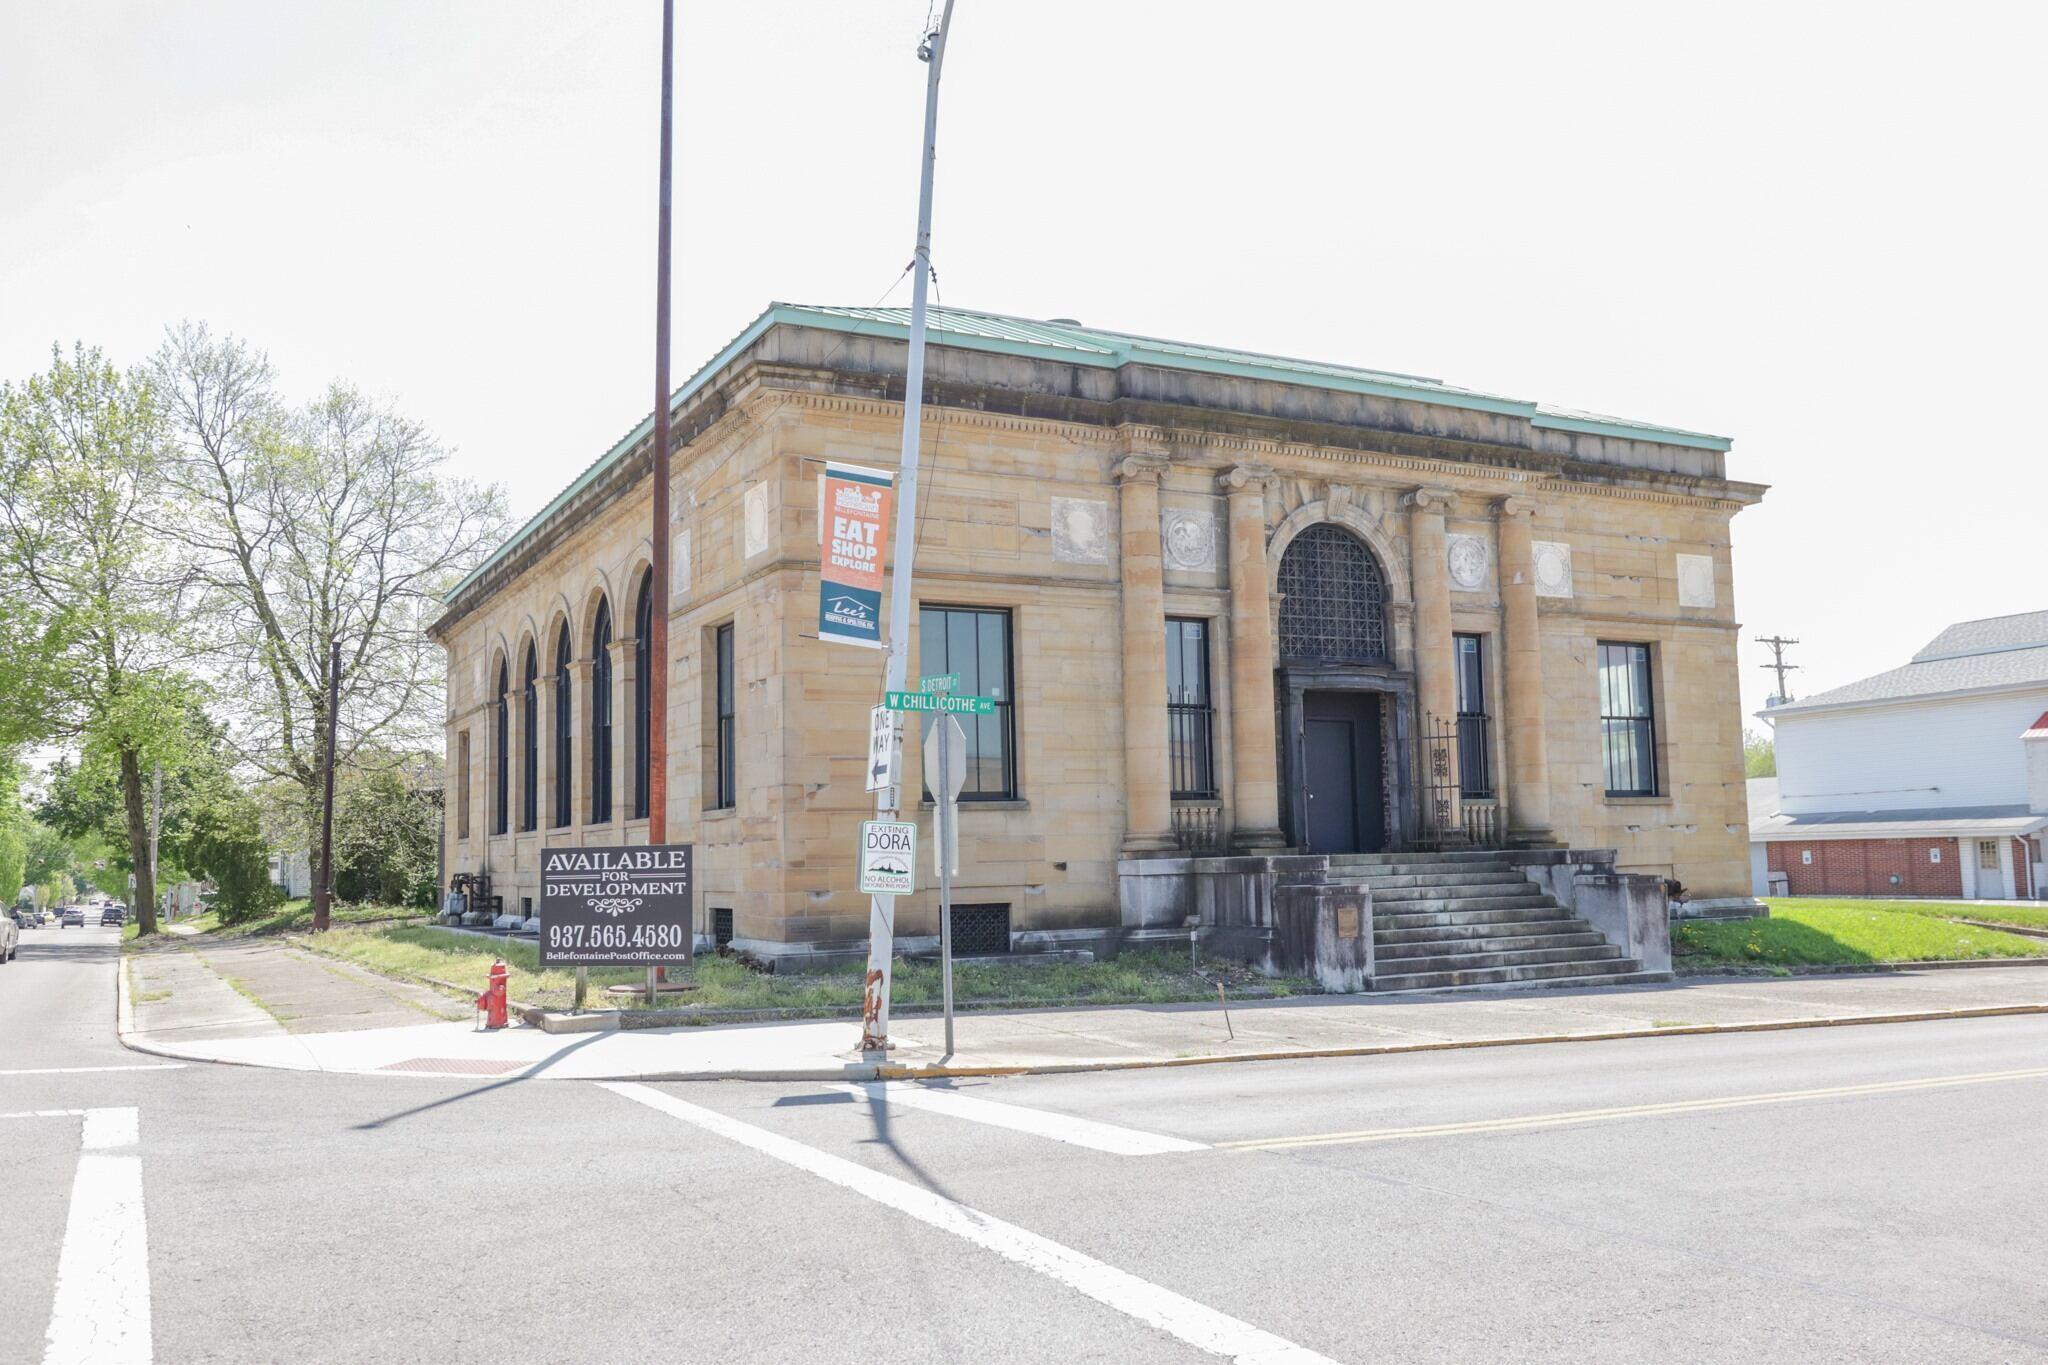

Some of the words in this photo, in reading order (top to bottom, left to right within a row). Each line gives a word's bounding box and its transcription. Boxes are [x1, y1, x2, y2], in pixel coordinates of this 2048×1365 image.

[833, 516, 880, 545] EAT
[831, 538, 877, 561] SHOP
[831, 554, 876, 573] EXPLORE
[833, 601, 867, 618] Lee's
[921, 680, 926, 693] S
[927, 676, 952, 692] DETROIT
[889, 693, 900, 708] W
[902, 694, 976, 712] CHILLICOTHE
[980, 702, 991, 710] AVE
[874, 710, 890, 731] ONE
[872, 732, 890, 755] WAY
[871, 825, 909, 834] EXITING
[867, 832, 911, 851] DORA
[545, 851, 686, 871] AVAILABLE
[601, 871, 629, 882] FOR
[864, 875, 876, 883] NO
[877, 875, 910, 884] ALCOHOL
[545, 882, 686, 897] DEVELOPMENT
[550, 924, 682, 948] 937.565.4580
[546, 951, 685, 961] BellefontainePostOffice.com
